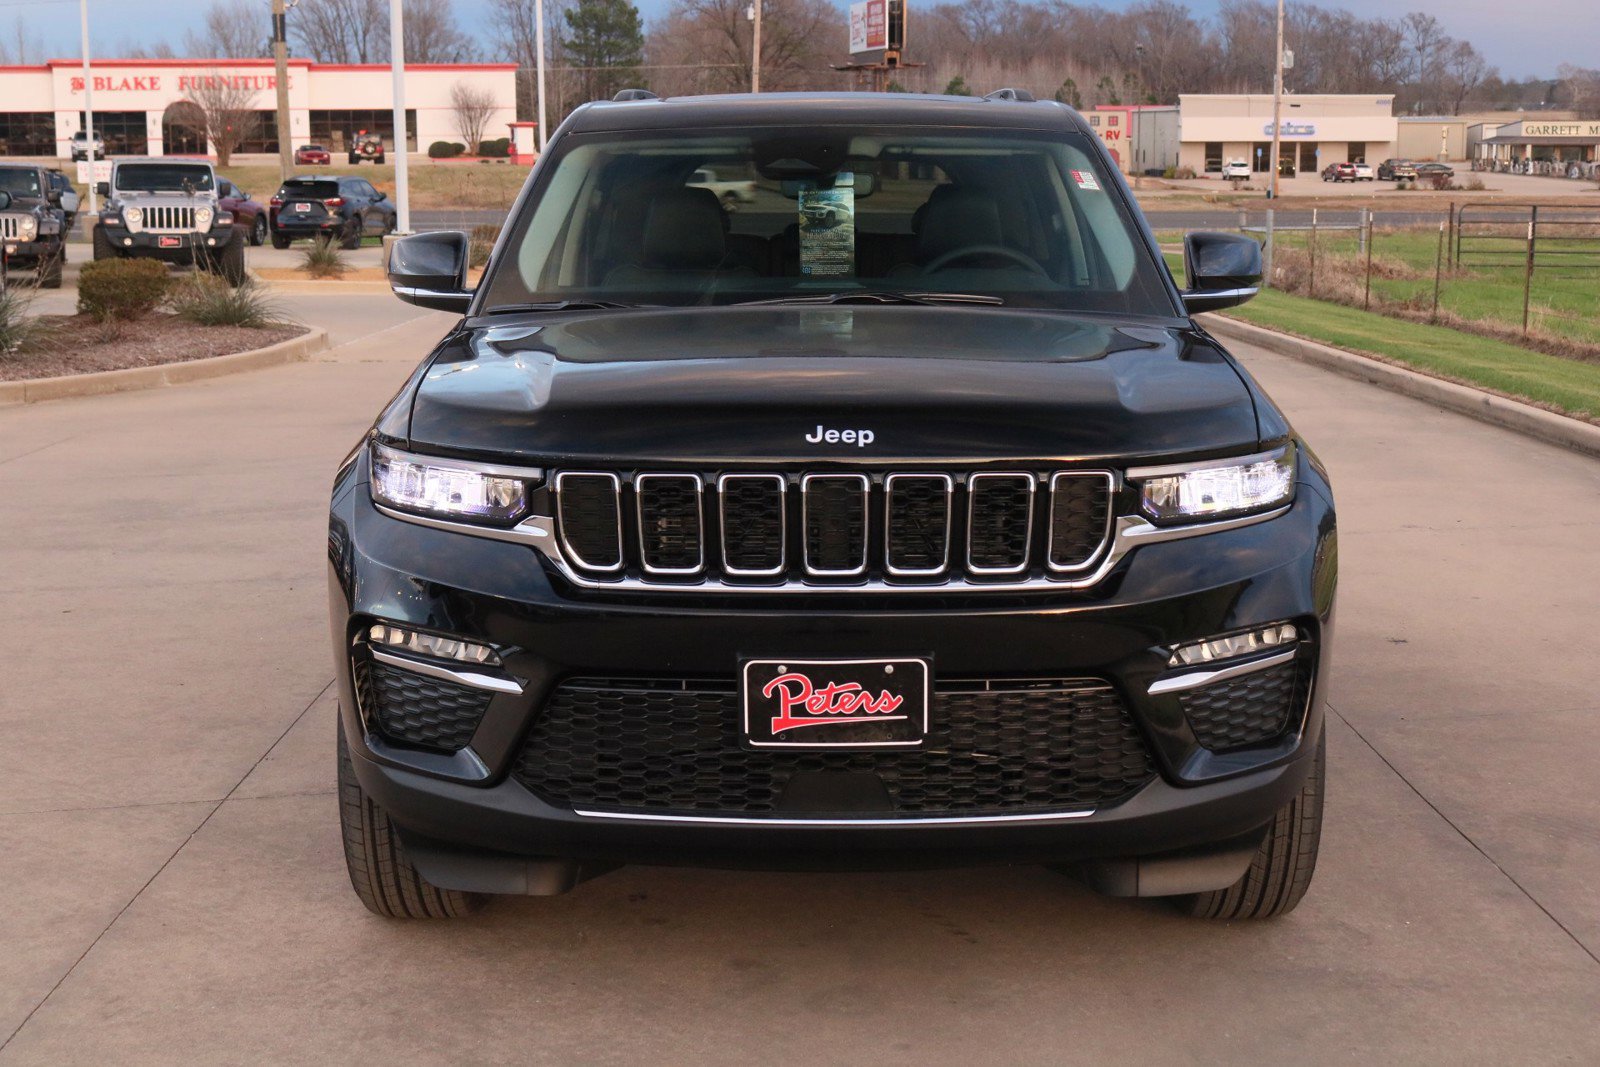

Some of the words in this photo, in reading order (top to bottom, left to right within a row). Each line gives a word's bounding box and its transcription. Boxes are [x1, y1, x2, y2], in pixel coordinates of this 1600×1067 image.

[93, 76, 160, 91] BLAKE
[1105, 130, 1120, 140] RV
[1525, 124, 1581, 135] GARRETT
[805, 424, 875, 447] Jeep
[762, 672, 905, 734] Peters
